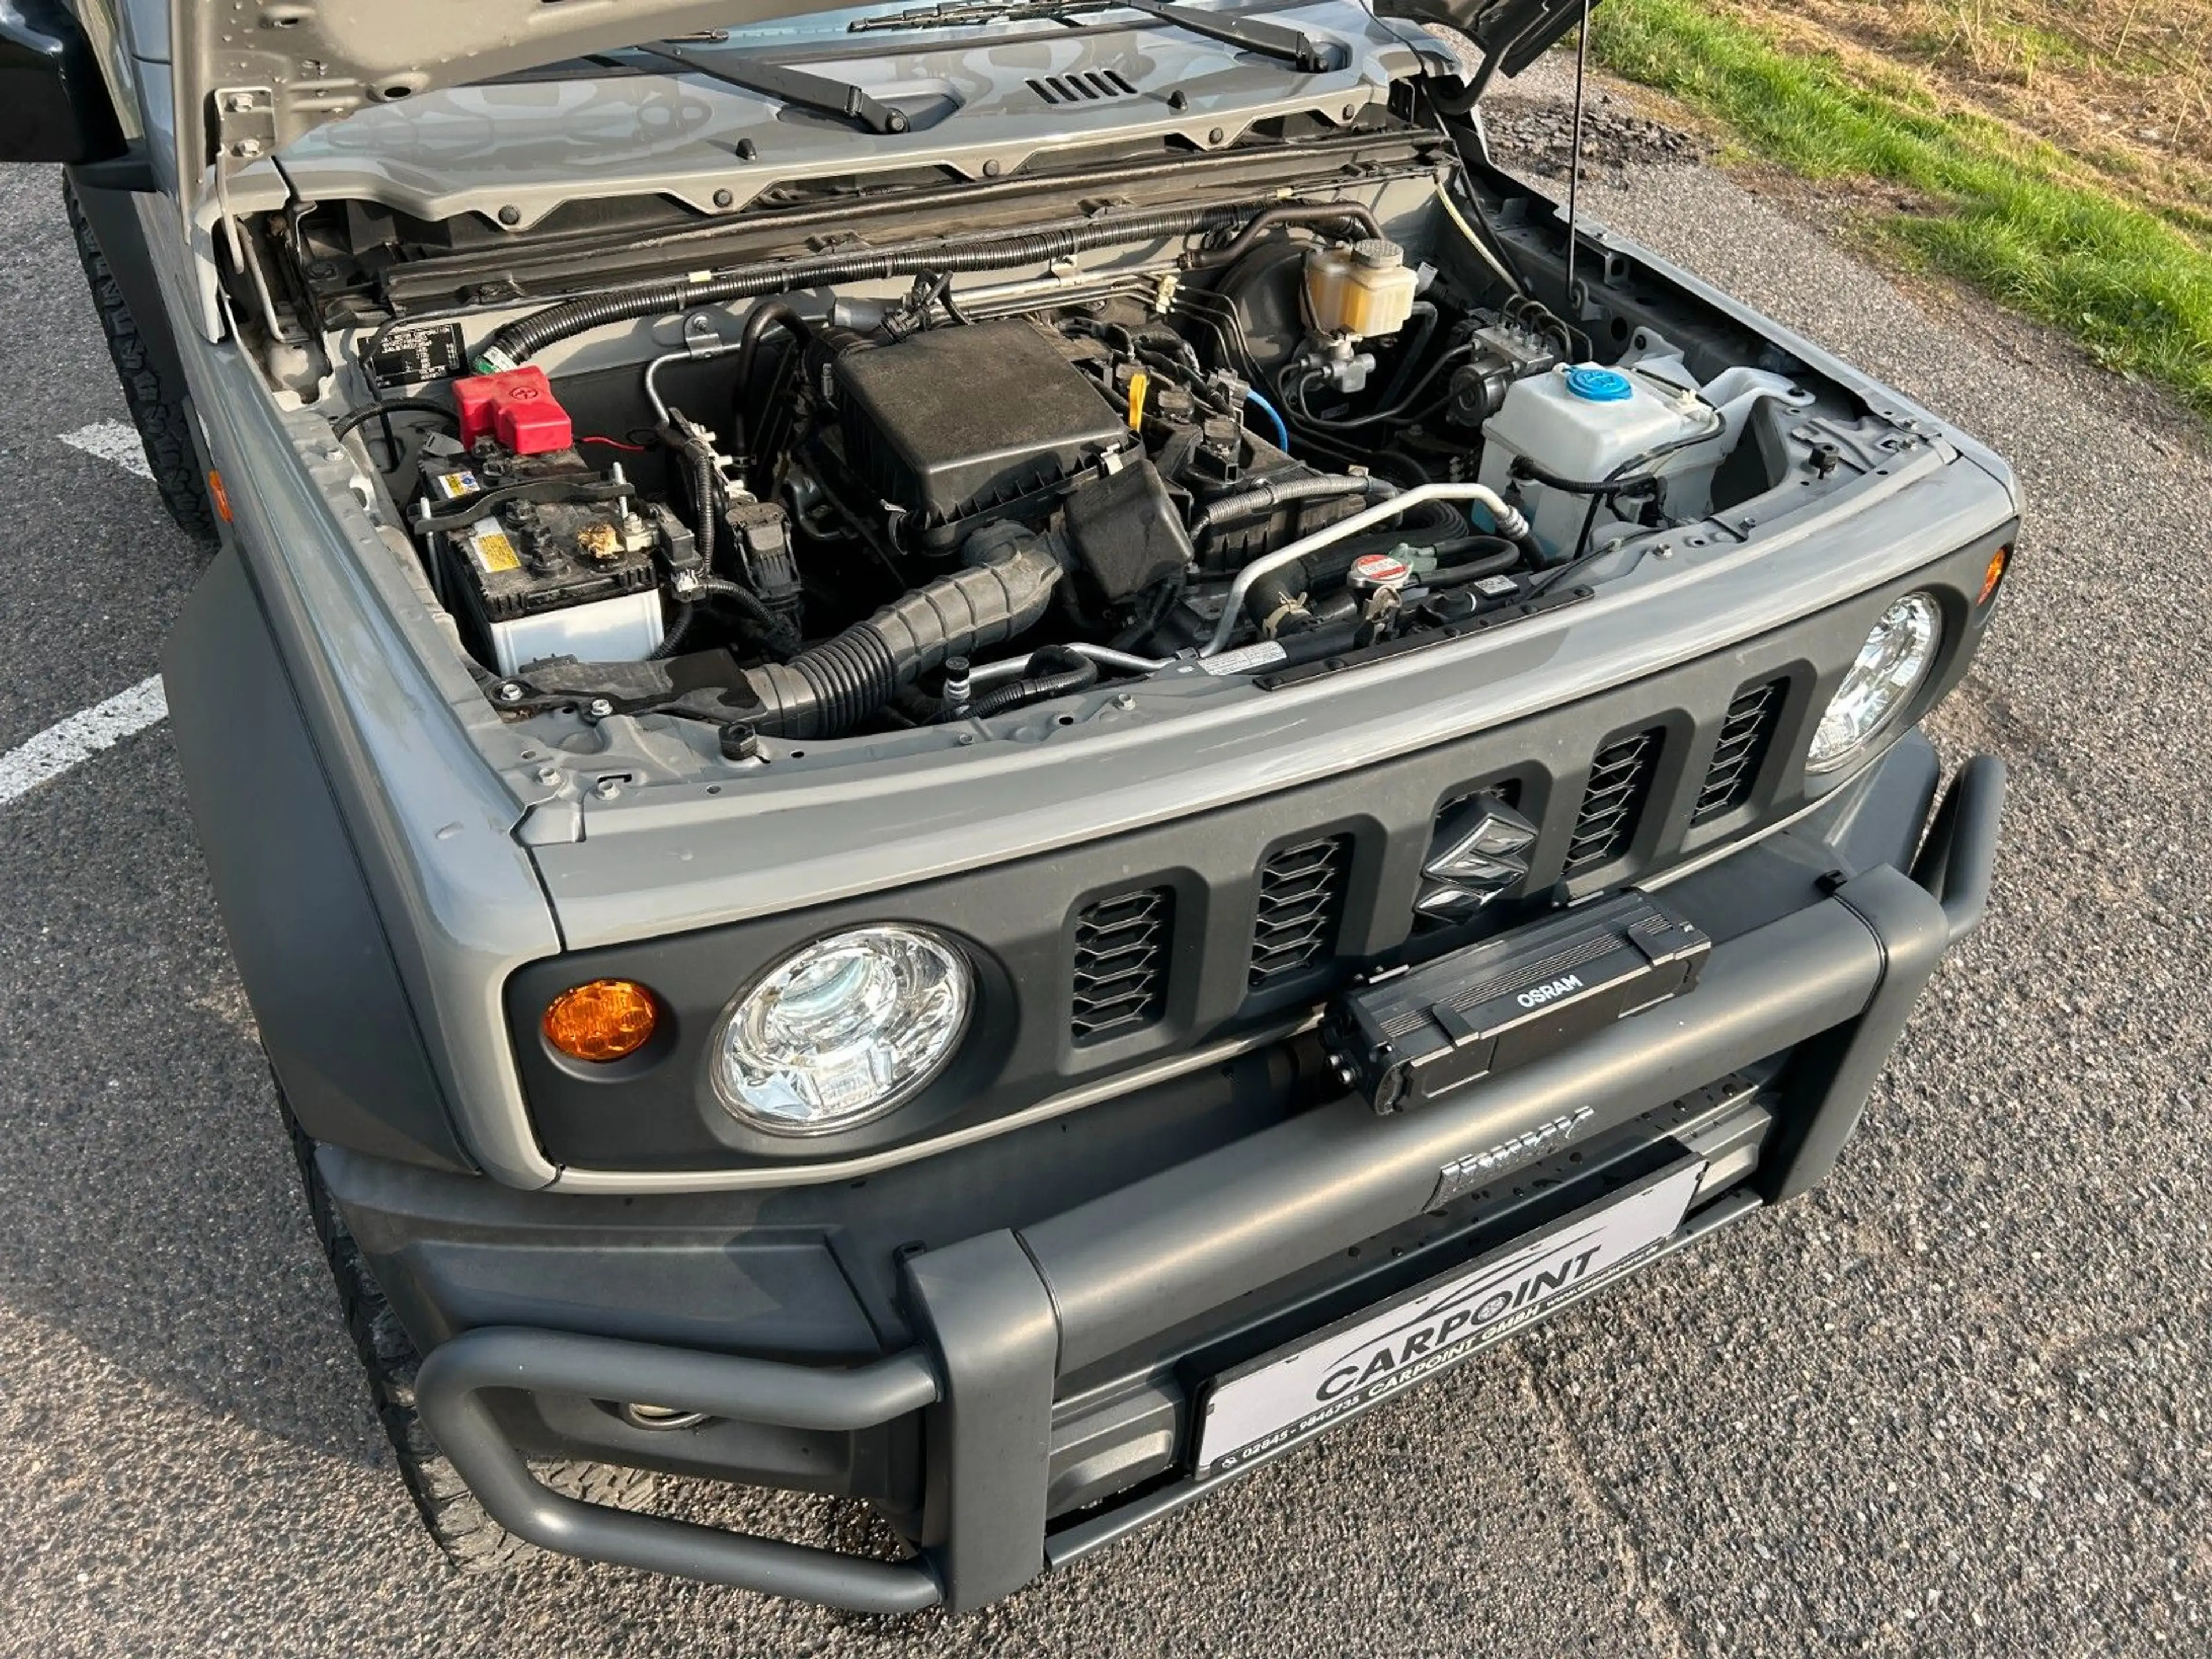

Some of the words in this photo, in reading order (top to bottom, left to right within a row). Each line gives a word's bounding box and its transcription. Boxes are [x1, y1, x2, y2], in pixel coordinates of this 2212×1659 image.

[1517, 974, 1584, 1007] OSRAM
[1315, 1244, 1602, 1402] CARPOINT
[1241, 1429, 1289, 1459] 02845
[1368, 1336, 1476, 1397] CARPOINT
